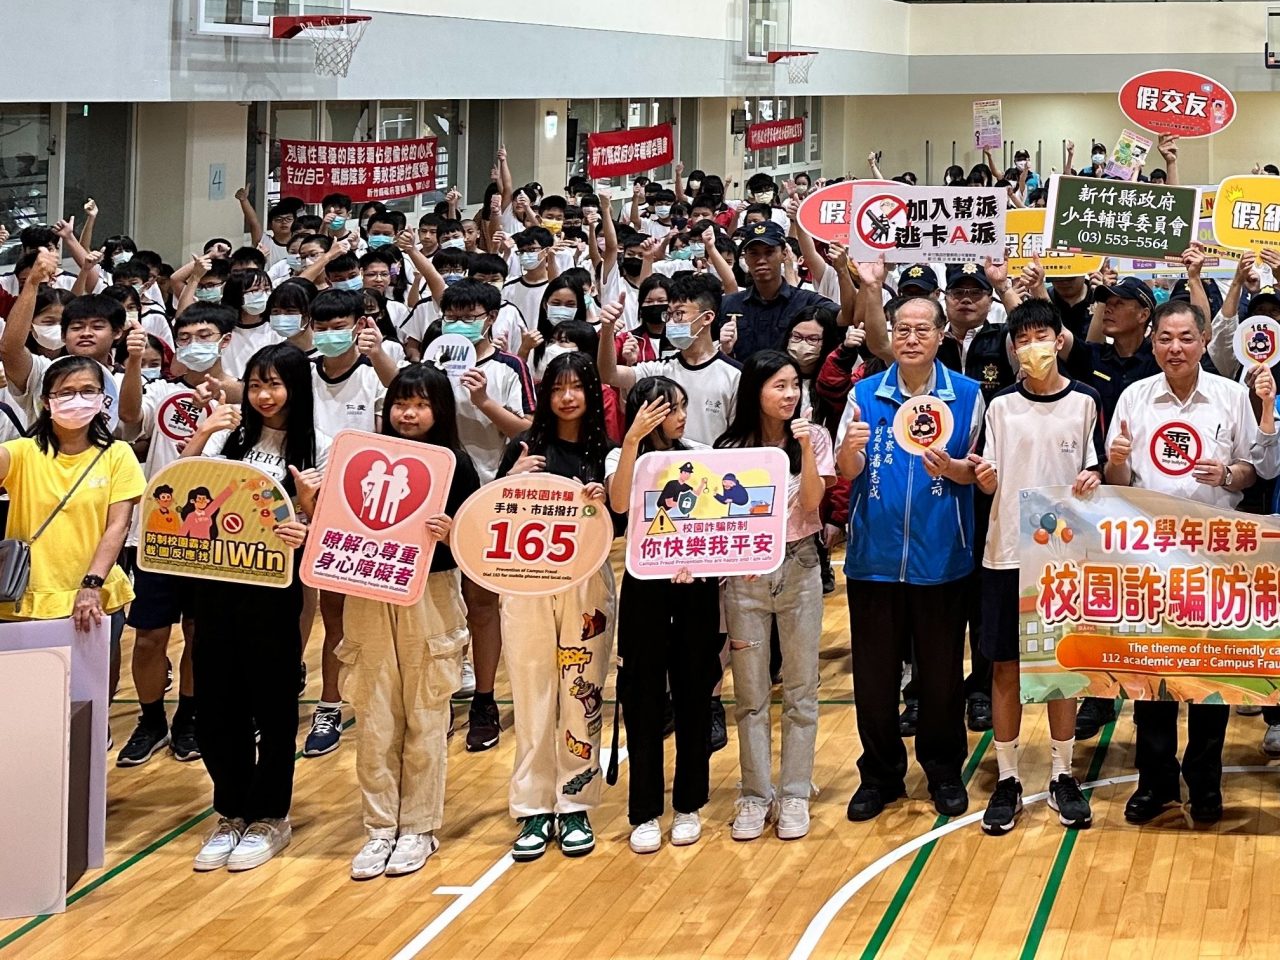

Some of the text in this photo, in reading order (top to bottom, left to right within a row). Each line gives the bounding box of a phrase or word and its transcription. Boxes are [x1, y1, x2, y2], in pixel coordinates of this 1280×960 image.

[1137, 85, 1208, 119] 假交友
[212, 170, 223, 191] 4
[906, 194, 998, 222] 加入幫派
[1078, 184, 1176, 212] 新竹縣政府
[1060, 206, 1189, 237] 少年輔導委員會
[895, 222, 997, 249] 逃卡A派
[1077, 230, 1169, 250] (03) 553-5564
[913, 404, 932, 414] 165
[1162, 431, 1191, 460] 霸
[502, 488, 574, 502] 防制校園詐騙
[494, 503, 578, 517] 手機、市話撥打
[682, 520, 748, 533] 校園詐騙防制
[322, 530, 419, 565] 瞭解與尊重
[486, 521, 576, 562] 165
[641, 533, 773, 559] 你快樂我平安
[214, 540, 223, 565] I
[227, 542, 284, 572] Win
[315, 551, 414, 587] 身心障礙者
[1102, 653, 1120, 663] 112
[1123, 654, 1174, 666] academic
[1176, 658, 1200, 668] year
[1210, 658, 1254, 669] Campus
[1128, 643, 1148, 653] The
[1151, 643, 1186, 653] theme
[1189, 643, 1200, 653] of
[1203, 644, 1221, 654] the
[1224, 644, 1266, 657] friendly
